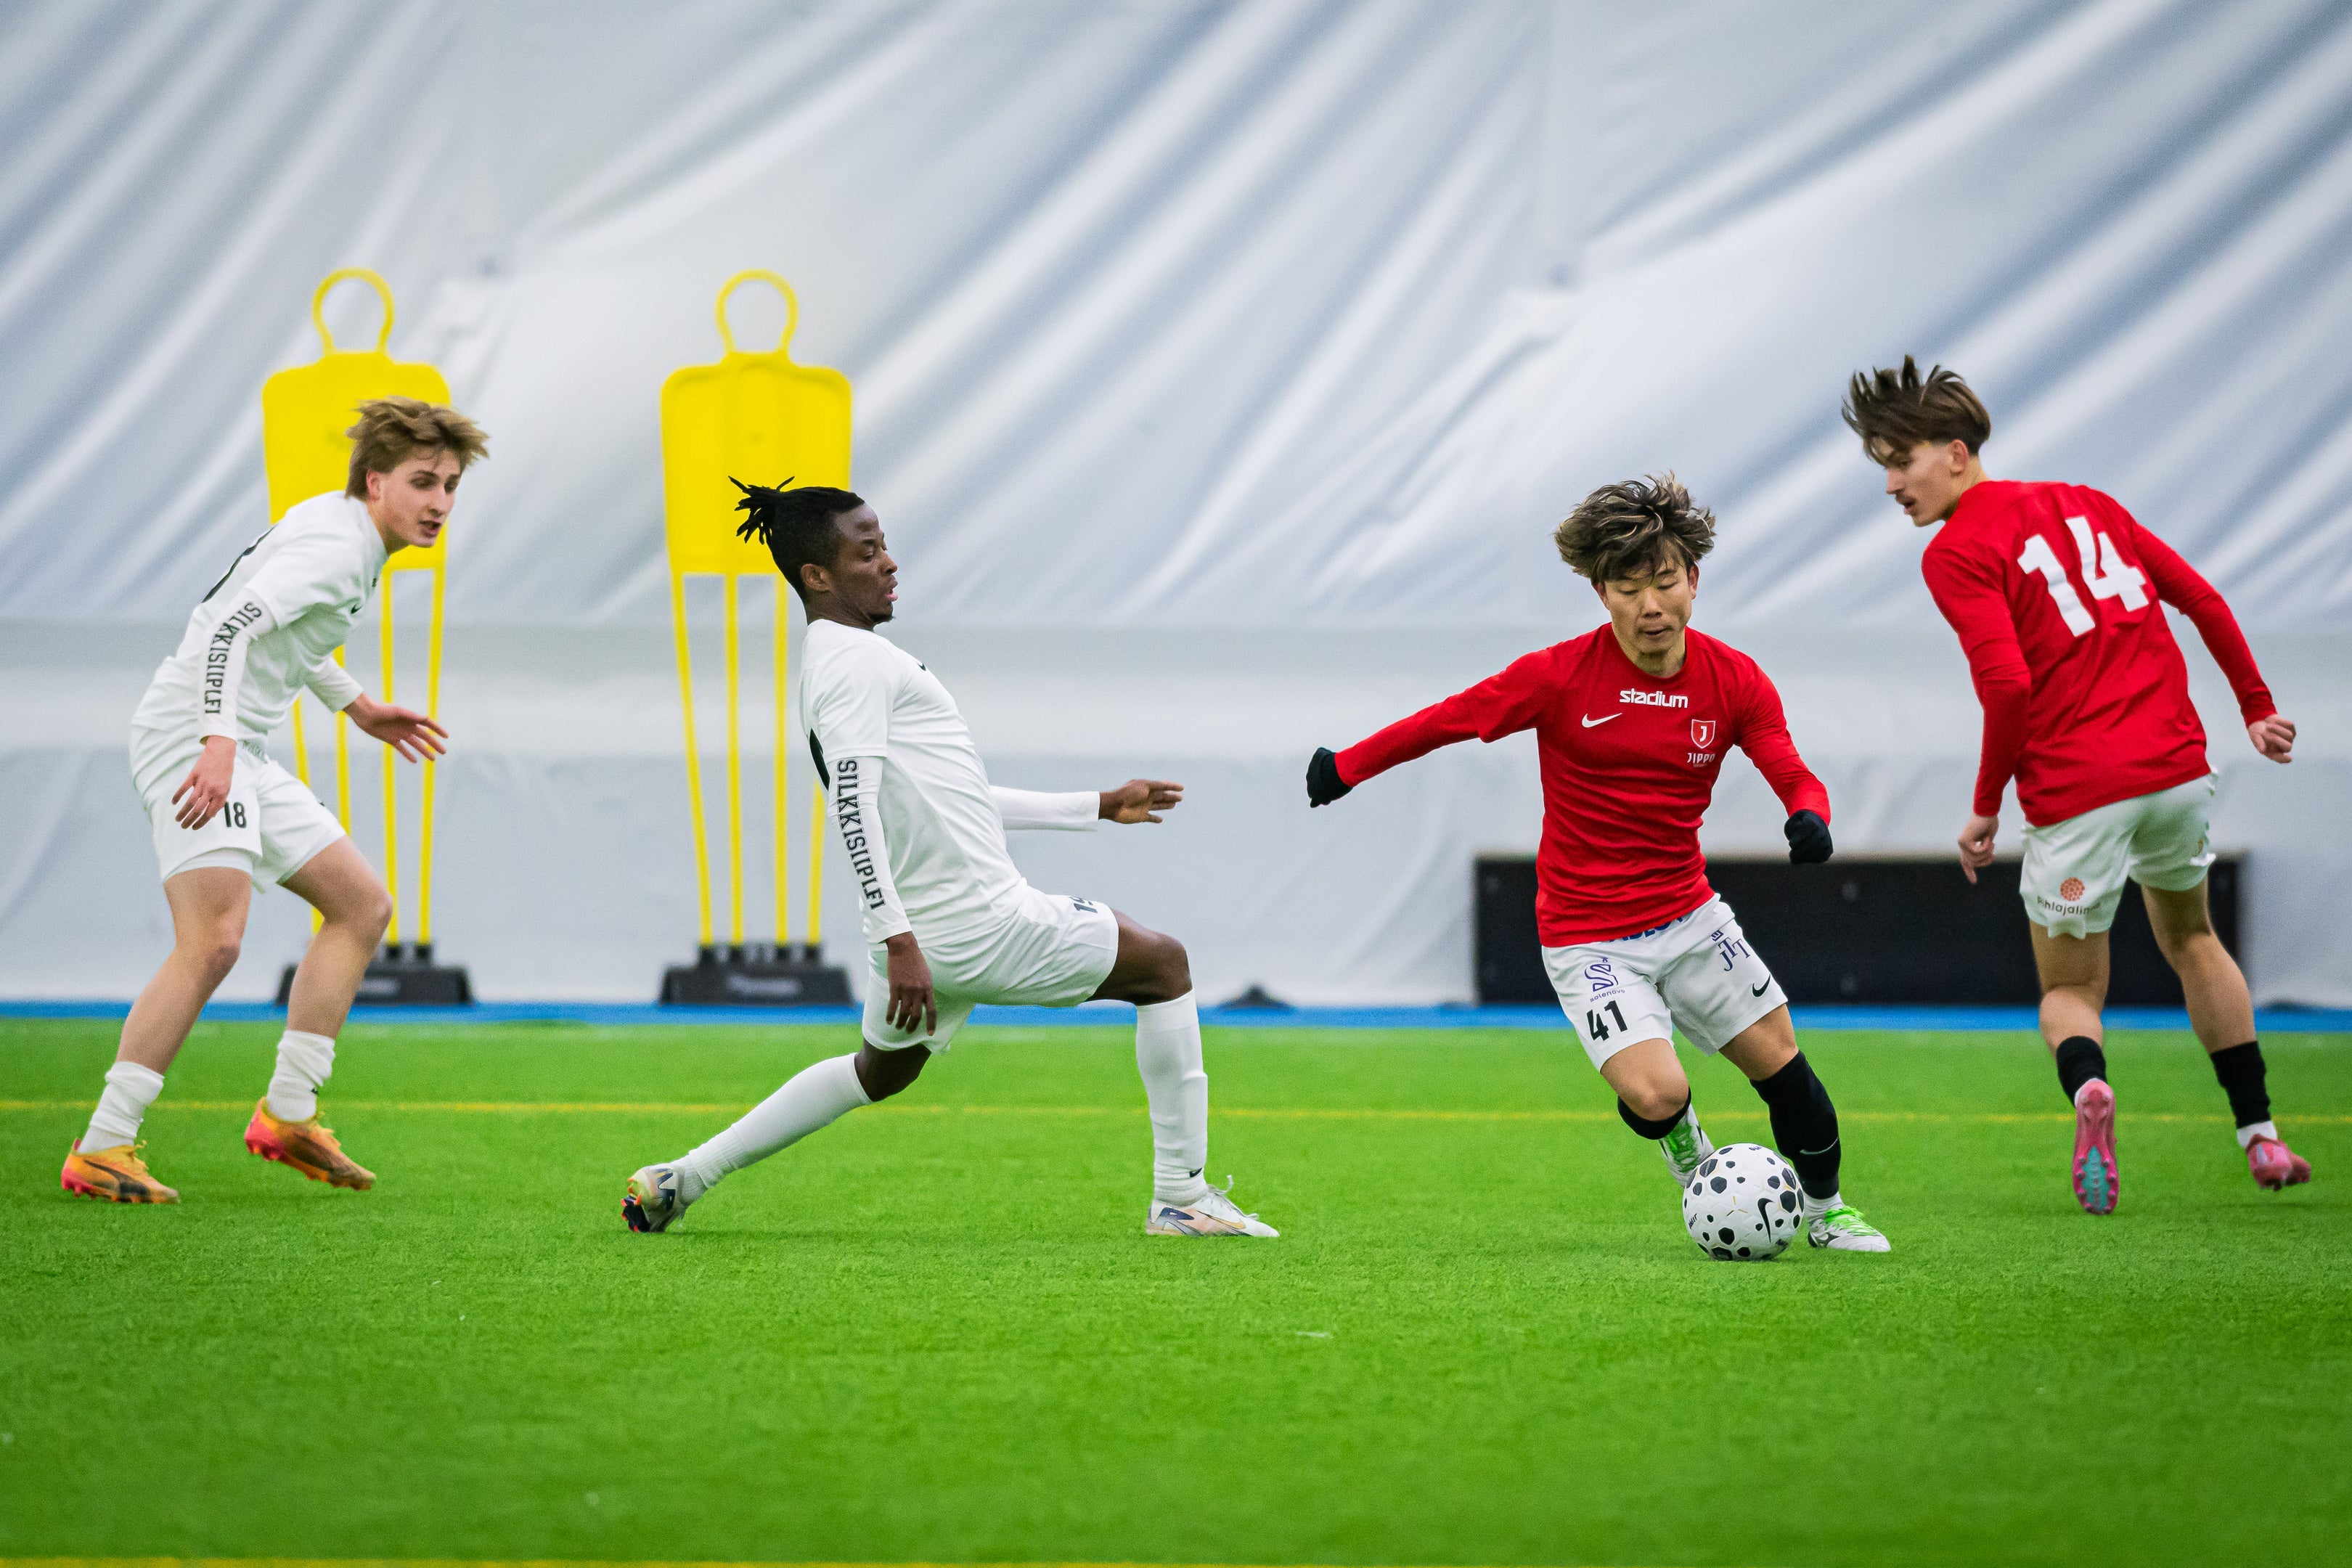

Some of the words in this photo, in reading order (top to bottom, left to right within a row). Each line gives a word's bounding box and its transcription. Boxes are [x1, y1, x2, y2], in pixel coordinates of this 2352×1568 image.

[2017, 516, 2149, 637] 14
[1619, 687, 1689, 709] stadium
[1699, 725, 1707, 743] J
[1686, 752, 1715, 764] JIPPO
[224, 801, 248, 828] 18
[2037, 895, 2100, 916] Pihlajalin
[1586, 1000, 1628, 1042] 41
